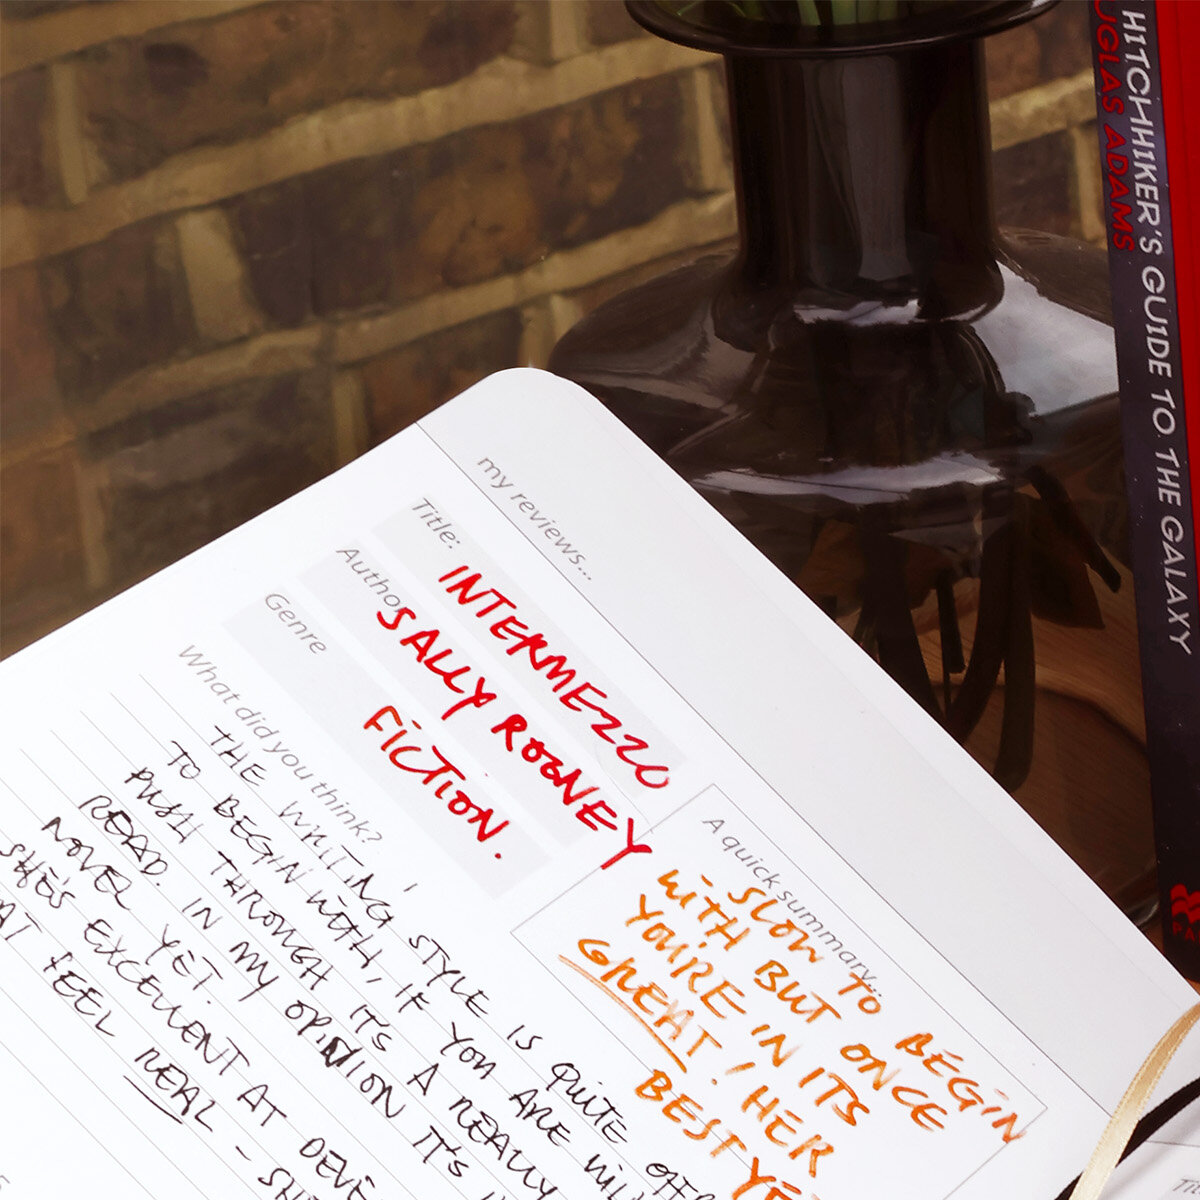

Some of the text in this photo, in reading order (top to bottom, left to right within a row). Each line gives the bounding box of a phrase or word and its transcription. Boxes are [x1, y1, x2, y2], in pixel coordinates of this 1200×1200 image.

[1104, 123, 1135, 251] ADAMS
[1121, 9, 1193, 656] HITCHHIKER'S GUIDE TO THE GALAXY
[412, 498, 460, 550] Title:
[476, 457, 592, 581] my reviews...
[264, 593, 327, 655] Genre
[178, 645, 383, 845] What did you think?
[377, 607, 653, 870] SALLY ROONEY
[702, 815, 780, 889] A quick
[168, 740, 201, 779] TO
[213, 794, 304, 883] BEGIN
[395, 983, 430, 1013] IF
[440, 1022, 497, 1079] YOU
[509, 1089, 571, 1147] ARE
[182, 898, 223, 930] IN
[229, 941, 280, 1002] MY
[210, 726, 628, 1144] THE STYLE IS QUITE
[727, 887, 1029, 1143] SLOW TO BEGIN
[751, 1024, 801, 1068] IN
[753, 960, 948, 1132] BUT ONCE
[236, 1085, 288, 1127] AT
[406, 1063, 440, 1096] A
[633, 1068, 747, 1159] BEST
[740, 1085, 835, 1178] HER
